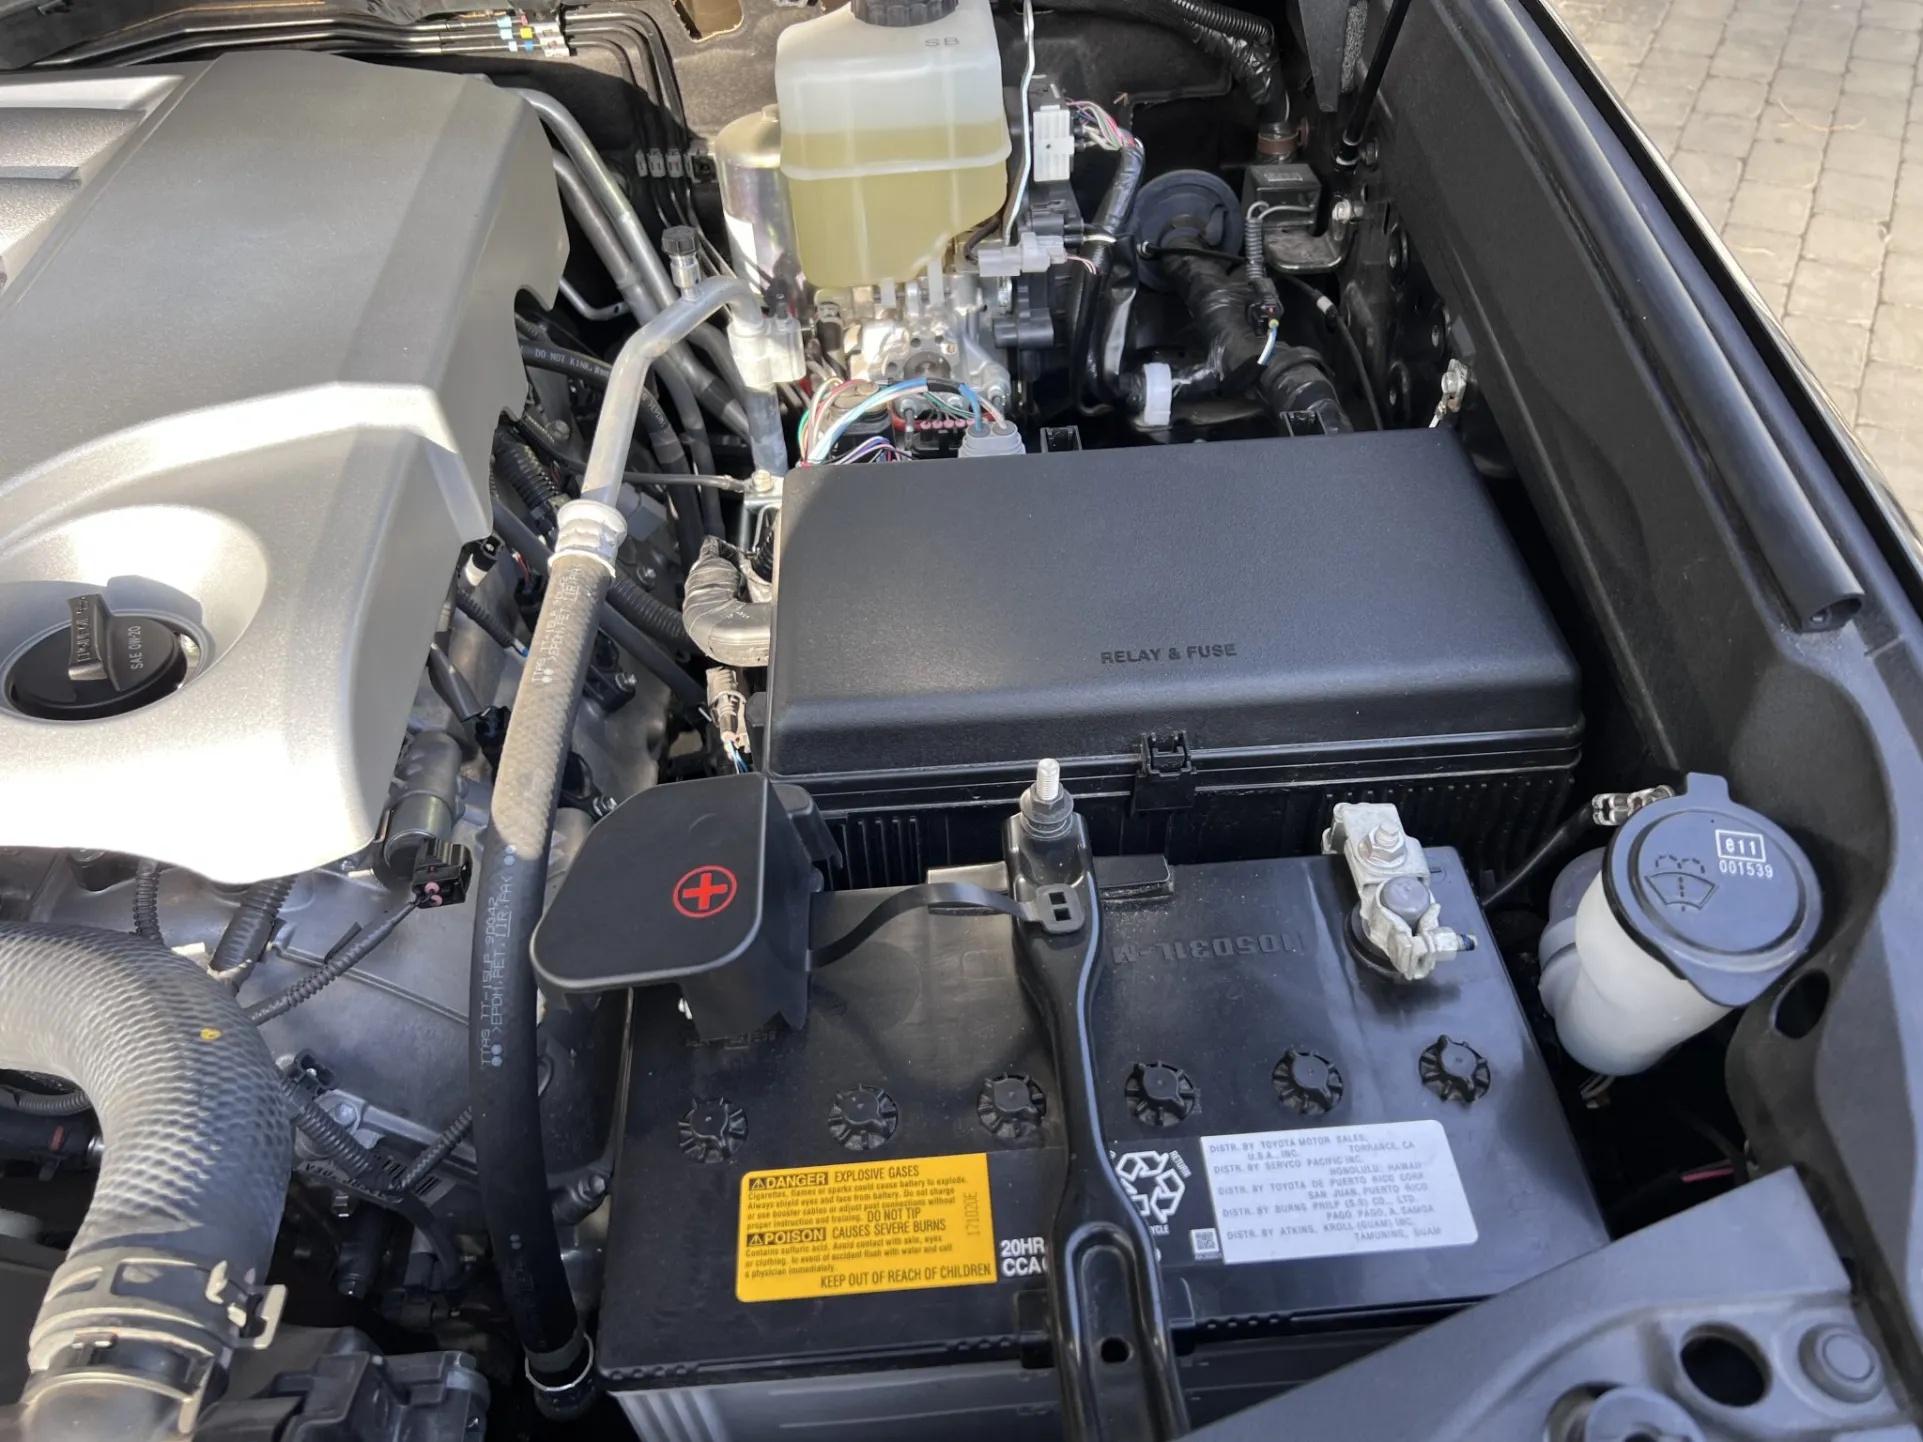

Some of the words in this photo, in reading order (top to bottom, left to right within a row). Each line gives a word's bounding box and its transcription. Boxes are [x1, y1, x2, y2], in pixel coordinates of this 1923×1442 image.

[128, 652, 144, 670] SAE
[1100, 647, 1162, 664] RELAY
[1168, 647, 1181, 661] &
[1186, 643, 1238, 660] FUSE
[1725, 837, 1757, 856] e11
[1719, 859, 1774, 879] 001539
[1242, 1142, 1254, 1151] BY
[1260, 1139, 1296, 1150] TOYOTA
[1299, 1136, 1330, 1146] MOTOR
[1402, 1140, 1415, 1150] CA
[1169, 1150, 1192, 1179] RETURN
[1247, 1163, 1260, 1172] BY
[766, 1173, 826, 1188] DANGER
[834, 1167, 884, 1182] EXPLOSIVE
[888, 1165, 920, 1178] GASES
[1252, 1184, 1264, 1193] BY
[1270, 1181, 1306, 1192] TOYOTA
[1312, 1179, 1324, 1188] DE
[1329, 1176, 1368, 1187] PUERTO
[1371, 1174, 1396, 1183] RICO
[1308, 1190, 1328, 1200] SAN
[1362, 1184, 1400, 1196] PUERTO
[1404, 1182, 1428, 1192] RICO
[868, 1210, 881, 1222] DO
[884, 1208, 902, 1220] NOT
[906, 1206, 922, 1219] TIP
[1257, 1206, 1268, 1215] BY
[1274, 1202, 1308, 1214] BURNS
[1326, 1210, 1352, 1220] PAGO
[764, 1228, 824, 1245] POISON
[832, 1223, 870, 1239] CAUSES
[874, 1220, 910, 1236] SEVERE
[913, 1218, 946, 1232] BURNS
[1262, 1228, 1274, 1237] BY
[1323, 1222, 1354, 1232] KROLL
[1000, 1236, 1045, 1257] 20HR
[820, 1274, 846, 1288] KEEP
[848, 1272, 869, 1286] OUT
[872, 1270, 886, 1284] OF
[888, 1268, 922, 1283] REACH
[924, 1266, 938, 1280] OF
[940, 1263, 992, 1278] CHILDREN
